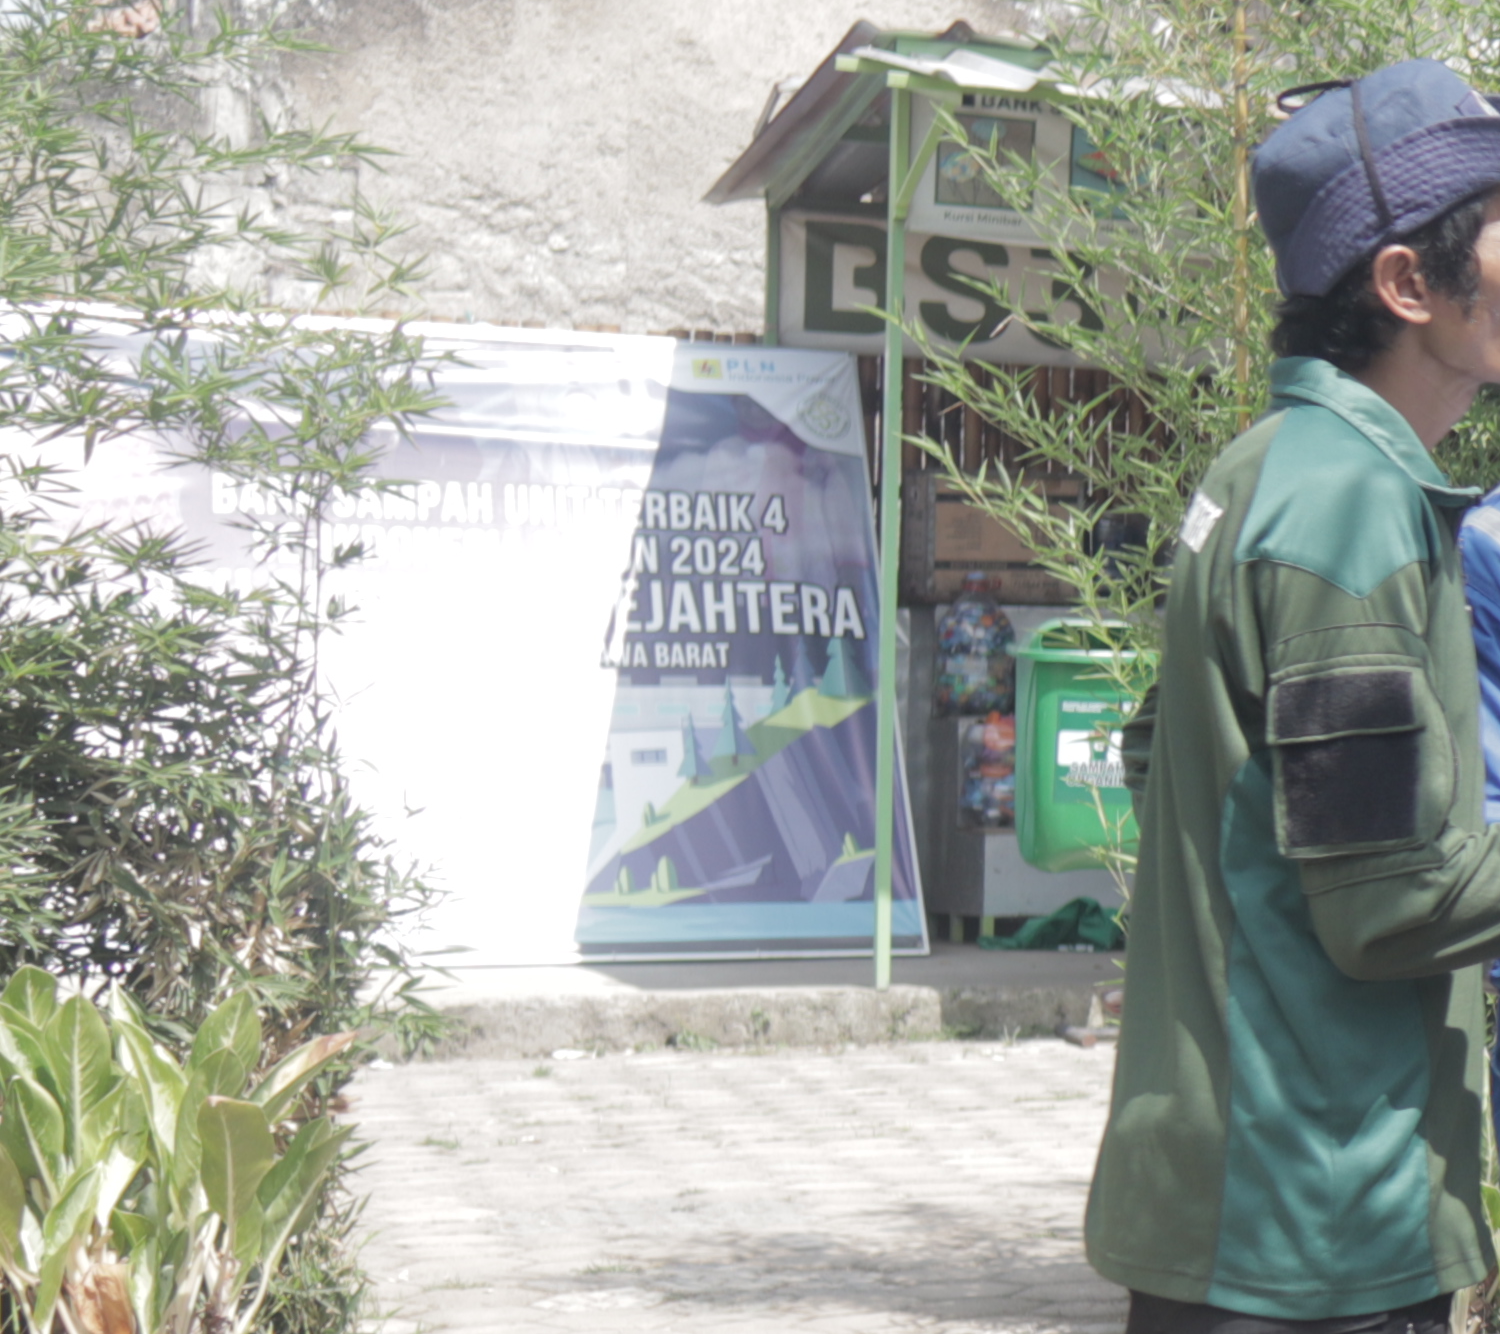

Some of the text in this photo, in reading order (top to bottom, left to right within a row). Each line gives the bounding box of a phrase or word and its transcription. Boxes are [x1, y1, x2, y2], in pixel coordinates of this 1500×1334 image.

[726, 358, 776, 374] PLN
[761, 494, 788, 535] 4
[669, 536, 766, 577] 2024
[621, 578, 867, 640] EJAHTERA
[654, 641, 730, 669] BARAT
